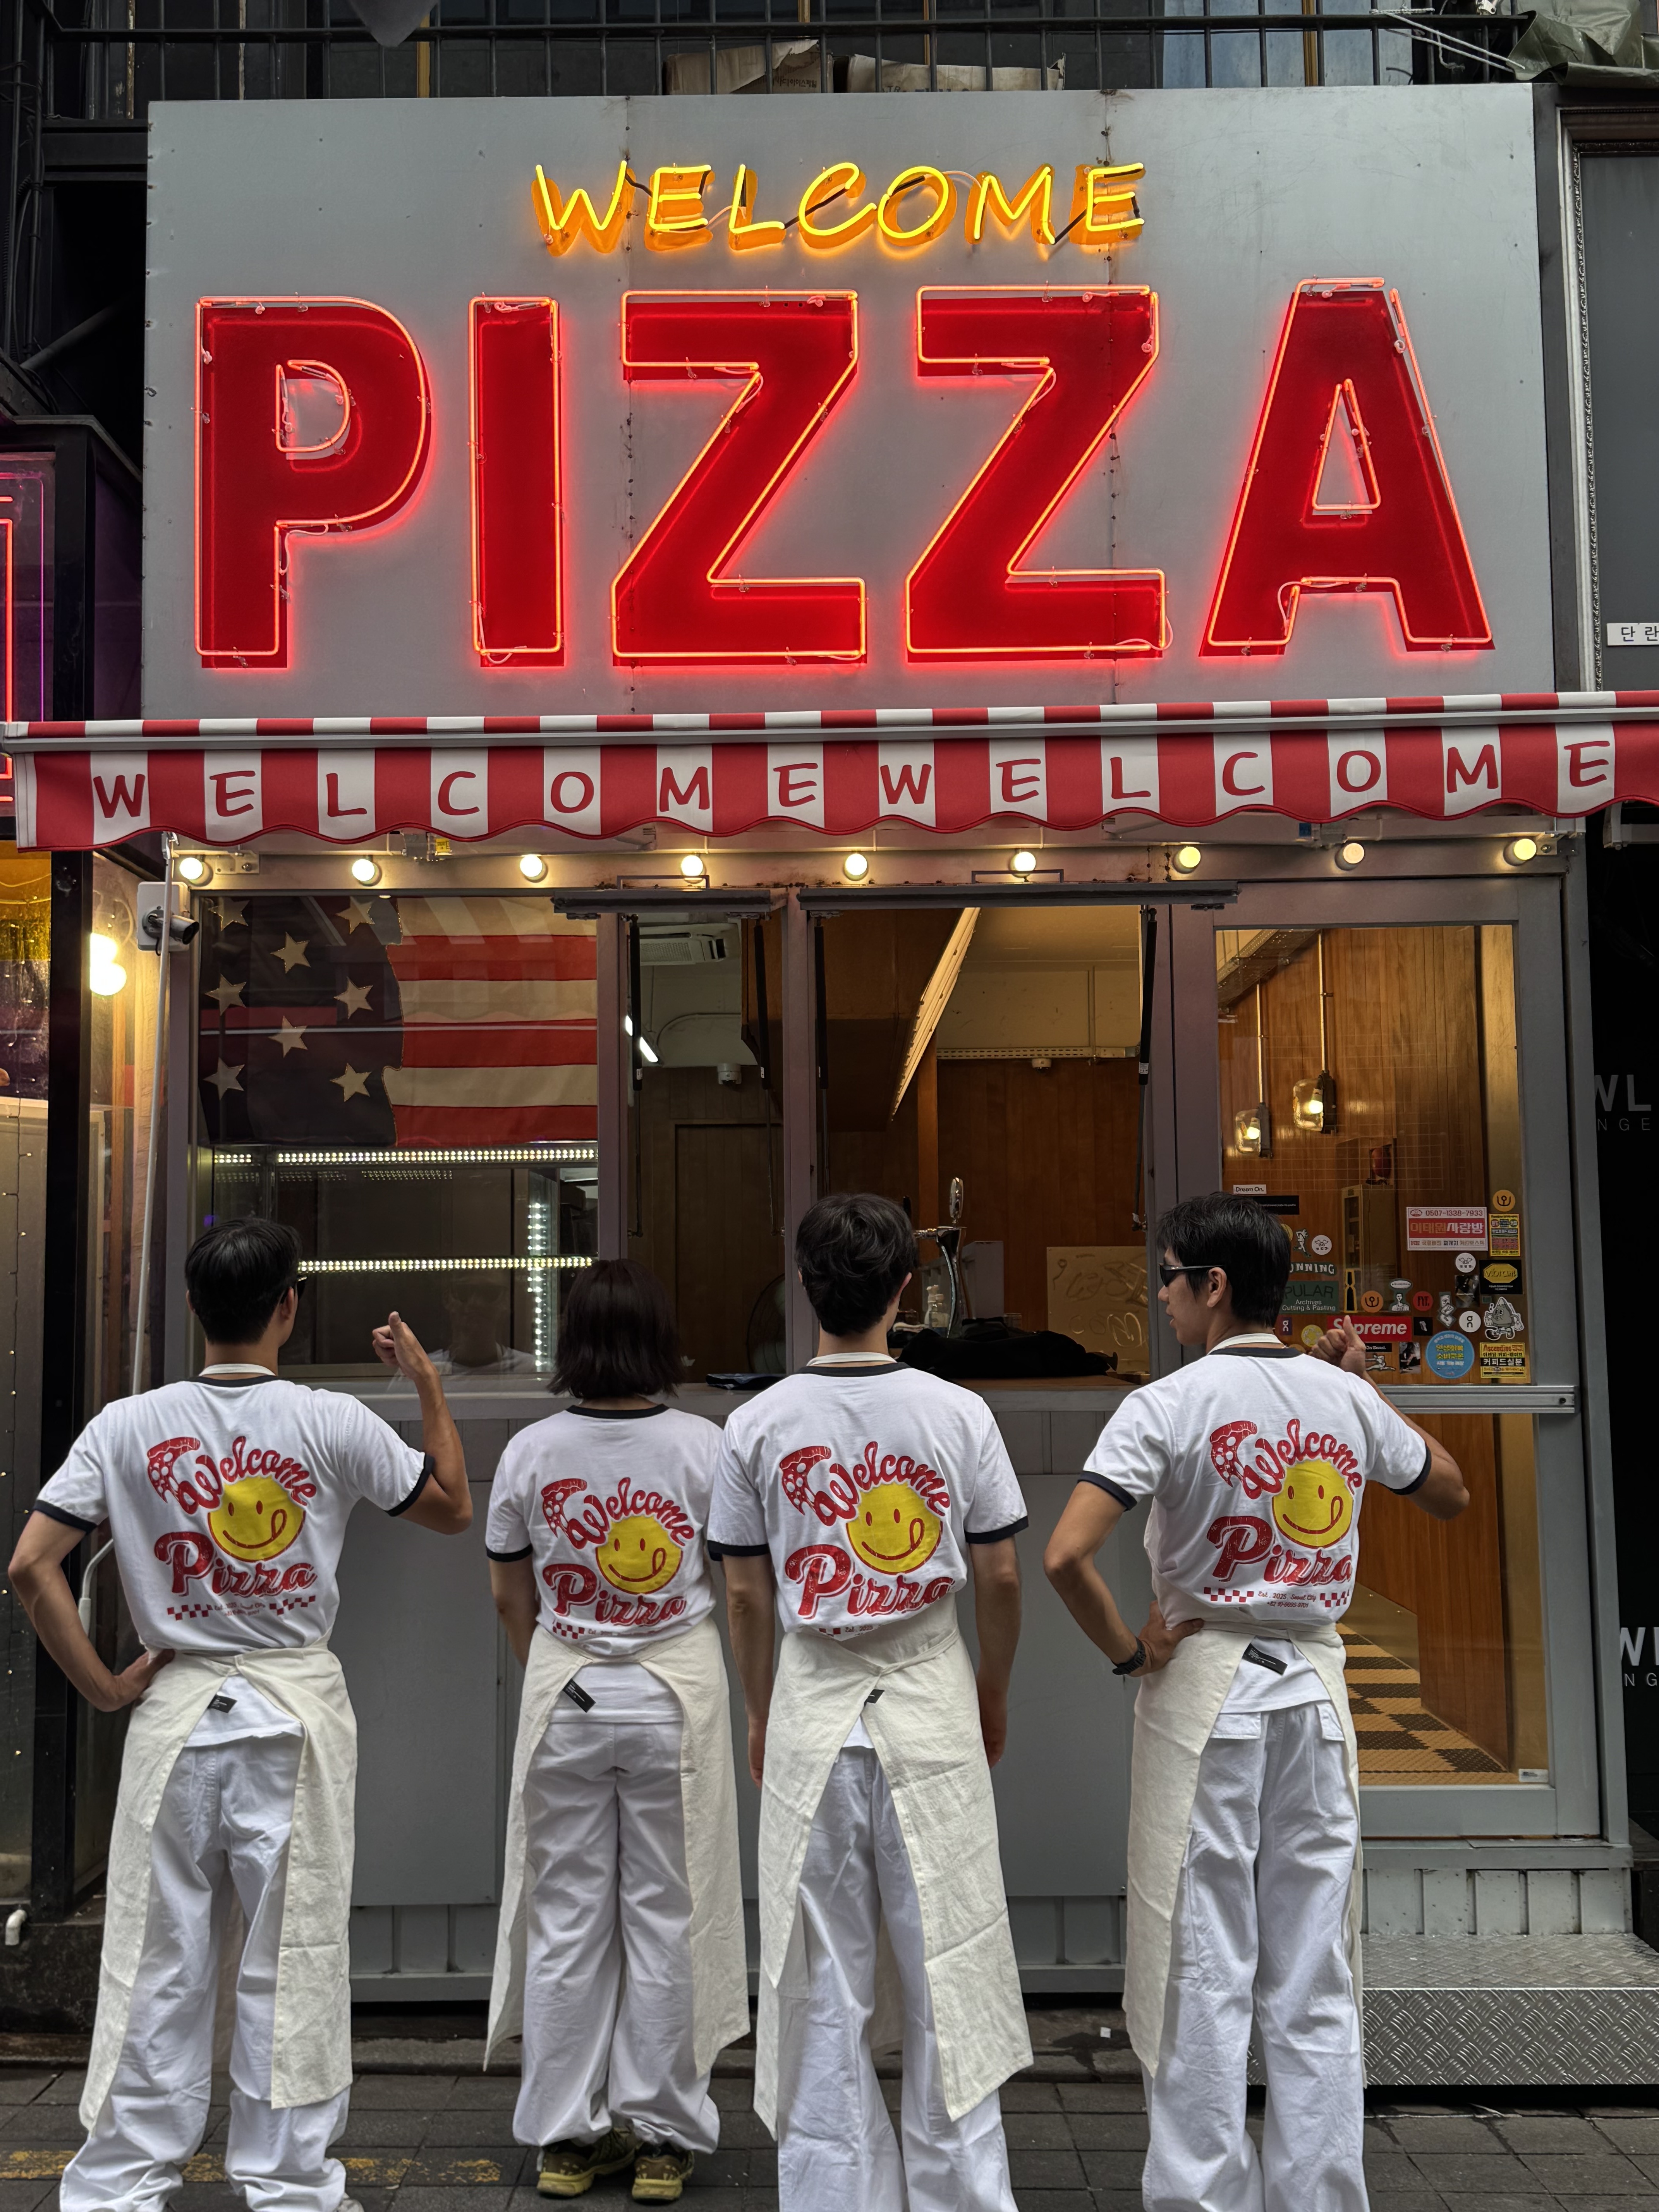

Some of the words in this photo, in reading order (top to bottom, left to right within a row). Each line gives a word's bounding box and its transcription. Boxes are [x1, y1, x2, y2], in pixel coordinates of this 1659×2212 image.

[531, 159, 1148, 256] WELCOME
[194, 277, 1495, 669] PIZZA
[92, 762, 819, 819] WELCOME
[880, 739, 1613, 806] WELCOME
[1594, 1074, 1652, 1111] WL
[1597, 1118, 1651, 1131] NGE
[1285, 1284, 1334, 1299] PULAR
[1333, 1318, 1407, 1335] Spreme
[1483, 1358, 1523, 1366] 커피드실분
[146, 1436, 317, 1515] Welcome
[779, 1441, 951, 1527] Welcome
[1210, 1419, 1362, 1500] Welcome
[541, 1477, 695, 1549] Welcome
[154, 1531, 318, 1597] Pizza
[785, 1544, 956, 1620] Pizza
[1206, 1516, 1354, 1586] Pizza
[543, 1563, 687, 1627] Pizza
[1624, 1673, 1658, 1686] NG
